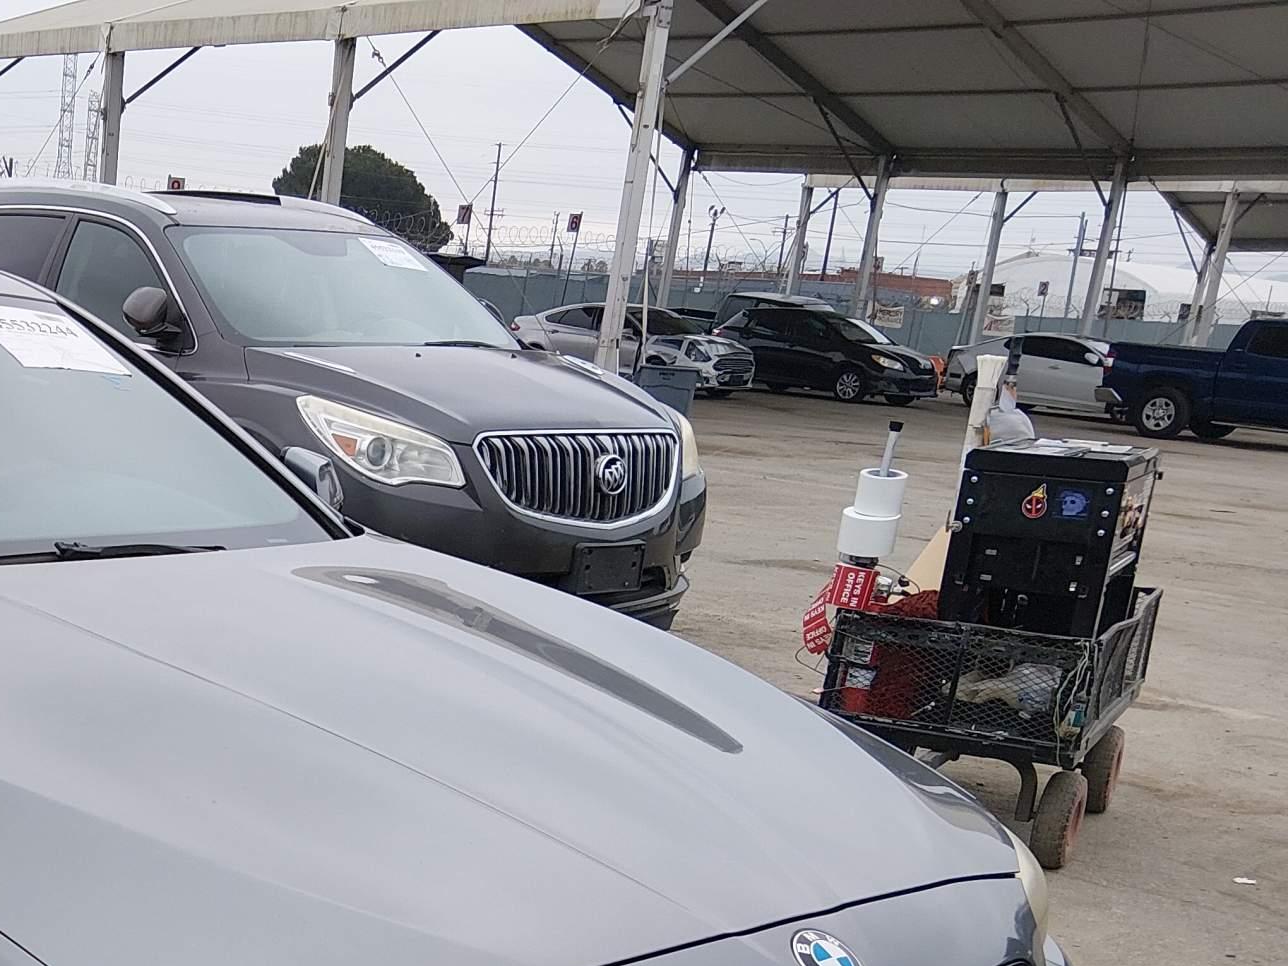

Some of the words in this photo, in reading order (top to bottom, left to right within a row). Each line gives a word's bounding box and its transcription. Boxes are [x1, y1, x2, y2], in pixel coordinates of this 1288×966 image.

[570, 215, 579, 231] 6
[840, 572, 855, 604] OFFICE
[853, 571, 866, 596] KEYS
[850, 597, 859, 607] IN
